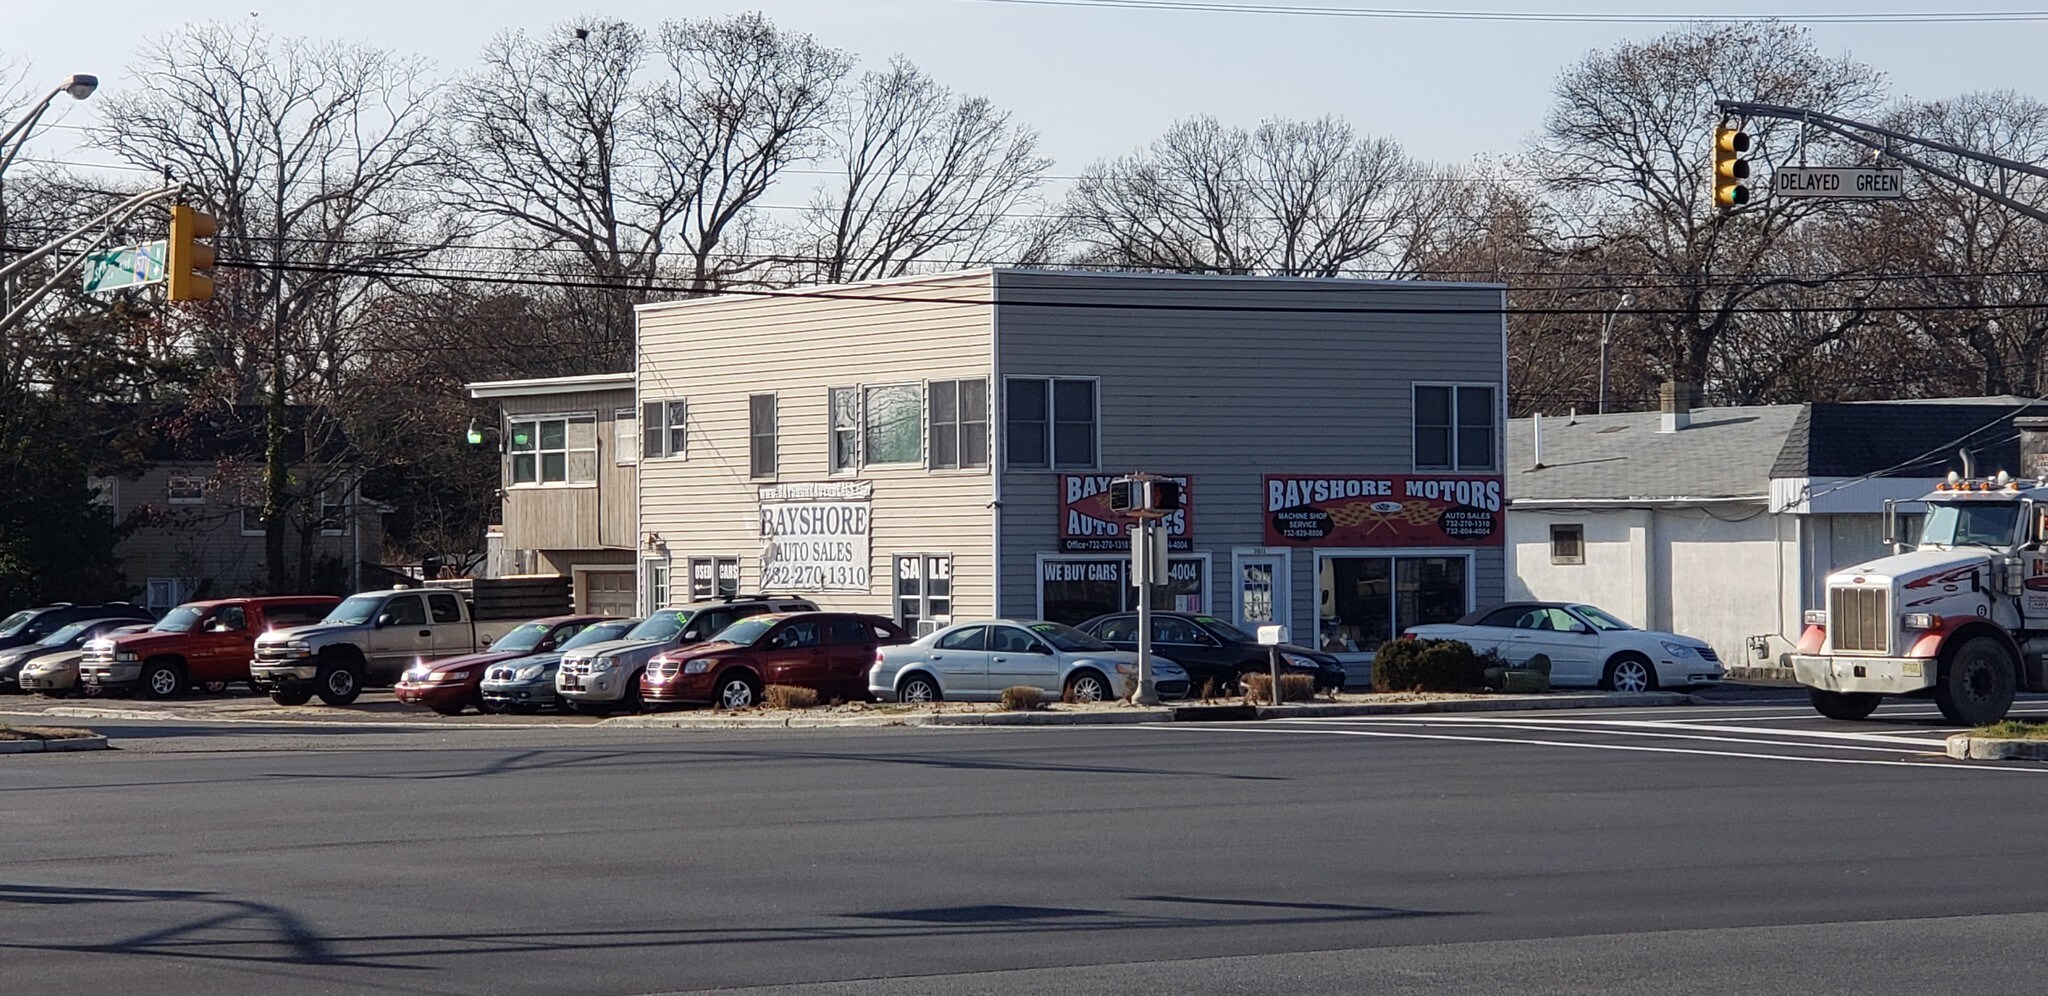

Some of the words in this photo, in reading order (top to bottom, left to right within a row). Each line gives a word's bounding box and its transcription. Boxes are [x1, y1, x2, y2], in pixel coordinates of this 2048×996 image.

[1781, 173, 1840, 190] DELAYED
[1856, 175, 1899, 191] GREEN
[1269, 480, 1391, 512] BAYSHORE
[1405, 481, 1500, 512] MOTORS
[760, 506, 867, 536] BAYSHORE
[1068, 509, 1118, 535] AUTO
[1125, 509, 1184, 535] SES
[775, 542, 809, 561] AUTO
[812, 542, 853, 561] SALES
[695, 564, 711, 579] USED
[719, 564, 737, 579] CARS
[900, 558, 949, 579] SALE
[1044, 564, 1062, 580] WE
[1064, 564, 1086, 580] BUY
[1088, 564, 1117, 580] CARS
